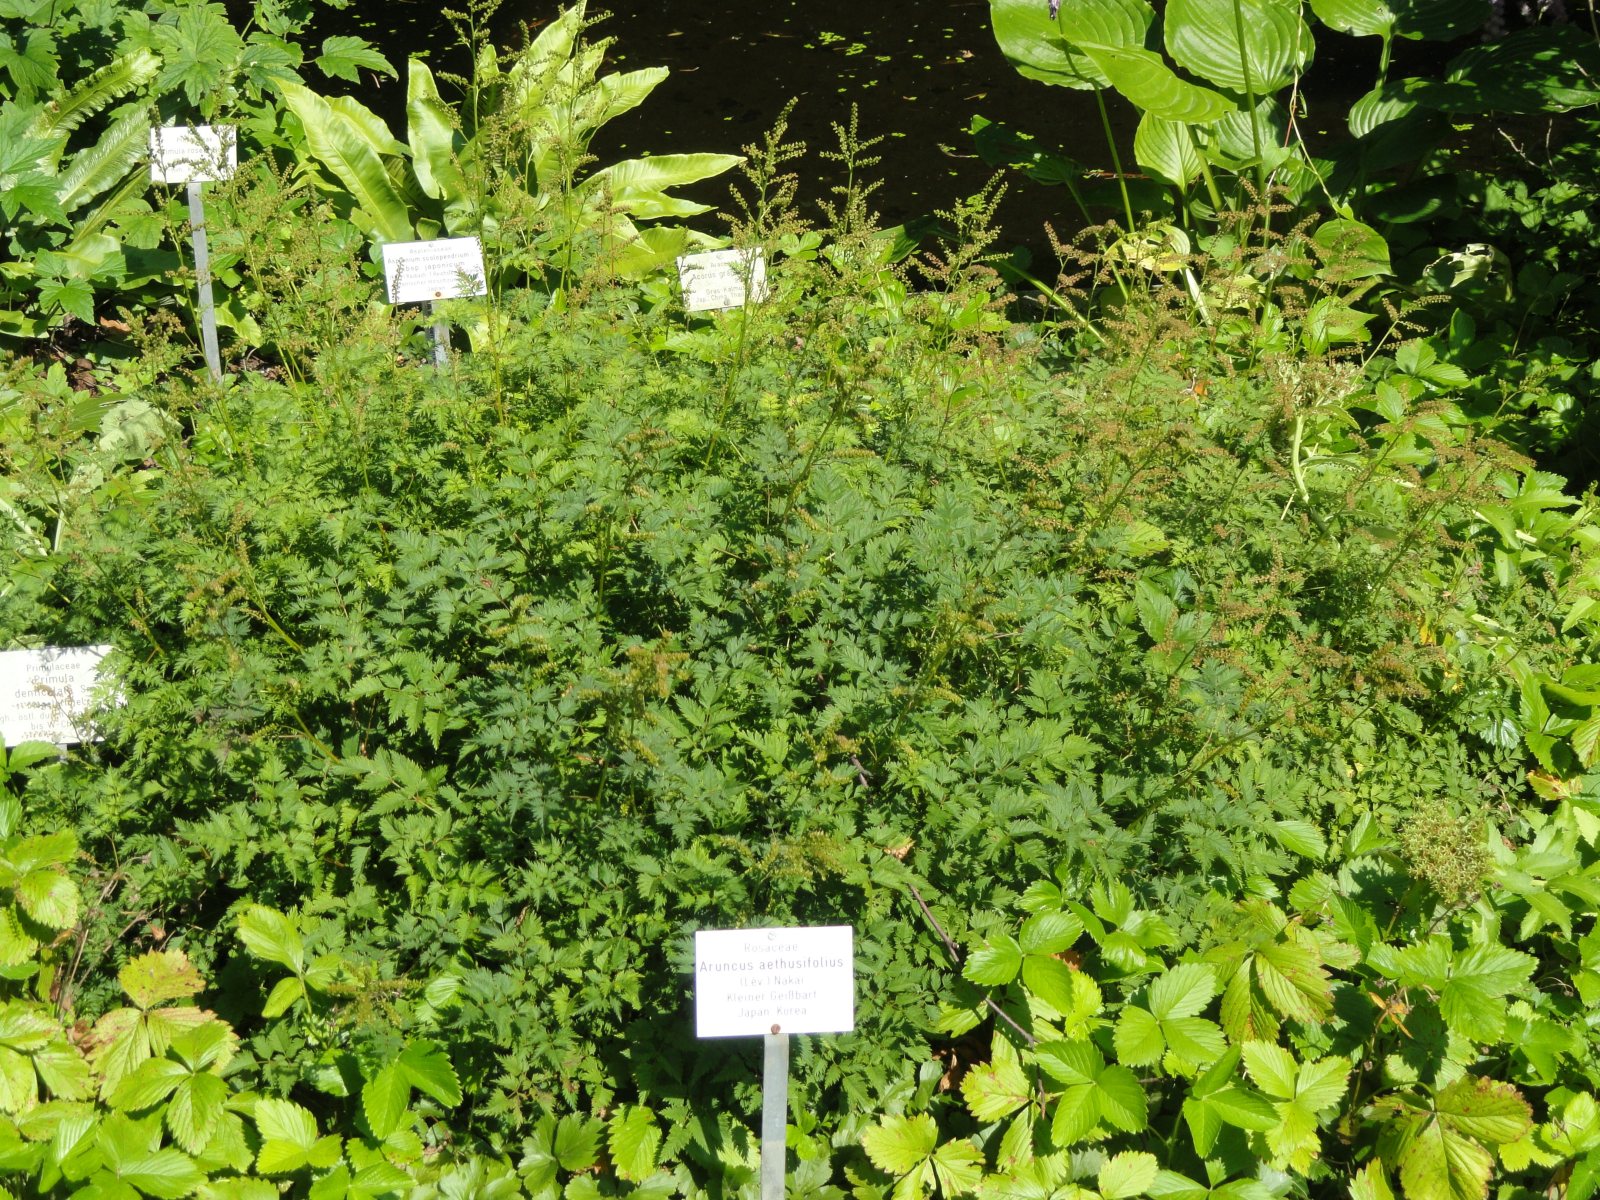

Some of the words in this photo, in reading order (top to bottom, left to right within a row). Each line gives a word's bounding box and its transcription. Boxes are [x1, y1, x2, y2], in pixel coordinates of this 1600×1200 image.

[424, 262, 465, 271] japonicum
[26, 662, 81, 672] Primulaceae
[34, 674, 74, 684] Primula
[744, 942, 798, 953] Rosaceae
[699, 960, 754, 973] Aruncus
[759, 956, 844, 970] aethusifolius
[774, 975, 805, 986] Nakai
[726, 992, 765, 1003] Kleiner
[769, 990, 817, 1002] Geißbart
[776, 1005, 807, 1017] Korea
